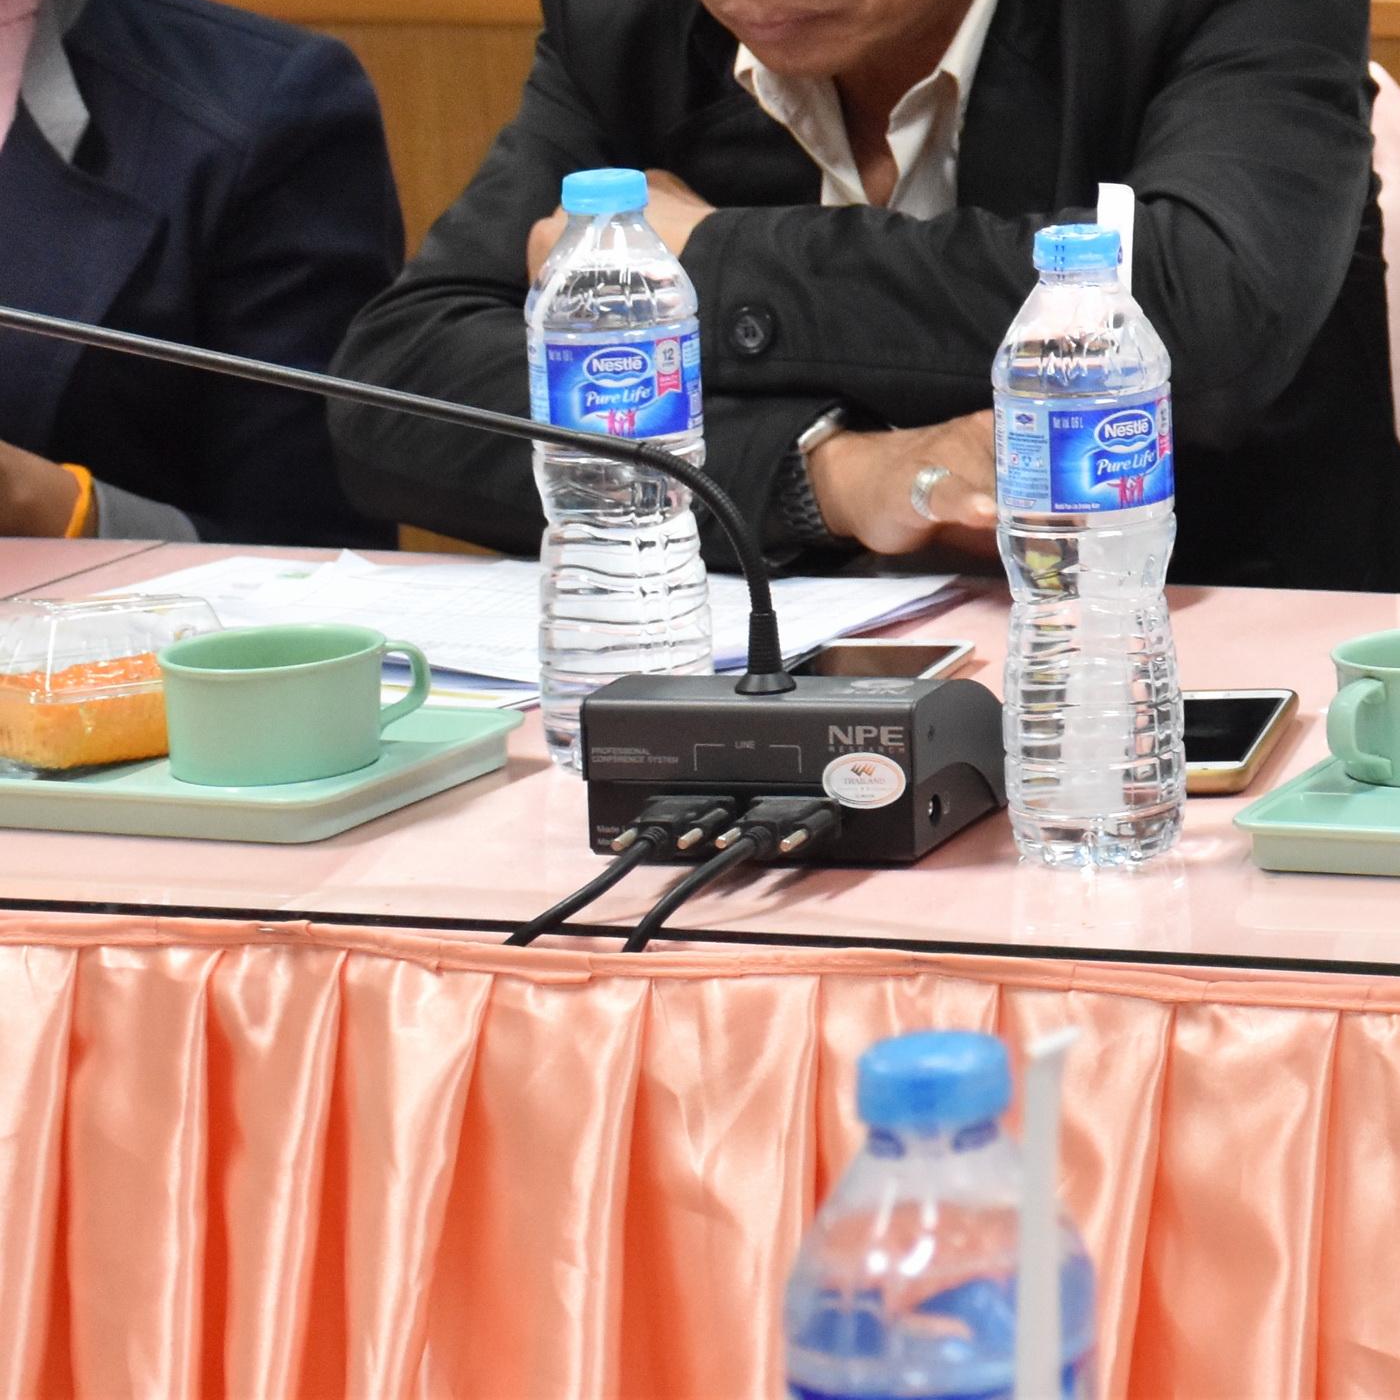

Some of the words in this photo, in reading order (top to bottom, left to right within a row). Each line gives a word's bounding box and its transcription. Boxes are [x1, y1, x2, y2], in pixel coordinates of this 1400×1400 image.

[592, 356, 643, 373] Nestlé
[662, 348, 674, 361] 12
[585, 390, 621, 407] Pure
[622, 385, 651, 403] Life
[1104, 418, 1149, 439] Nestlé
[1097, 458, 1131, 476] Pure
[1133, 449, 1156, 469] Life
[734, 740, 756, 749] LINE
[828, 724, 905, 747] NPE
